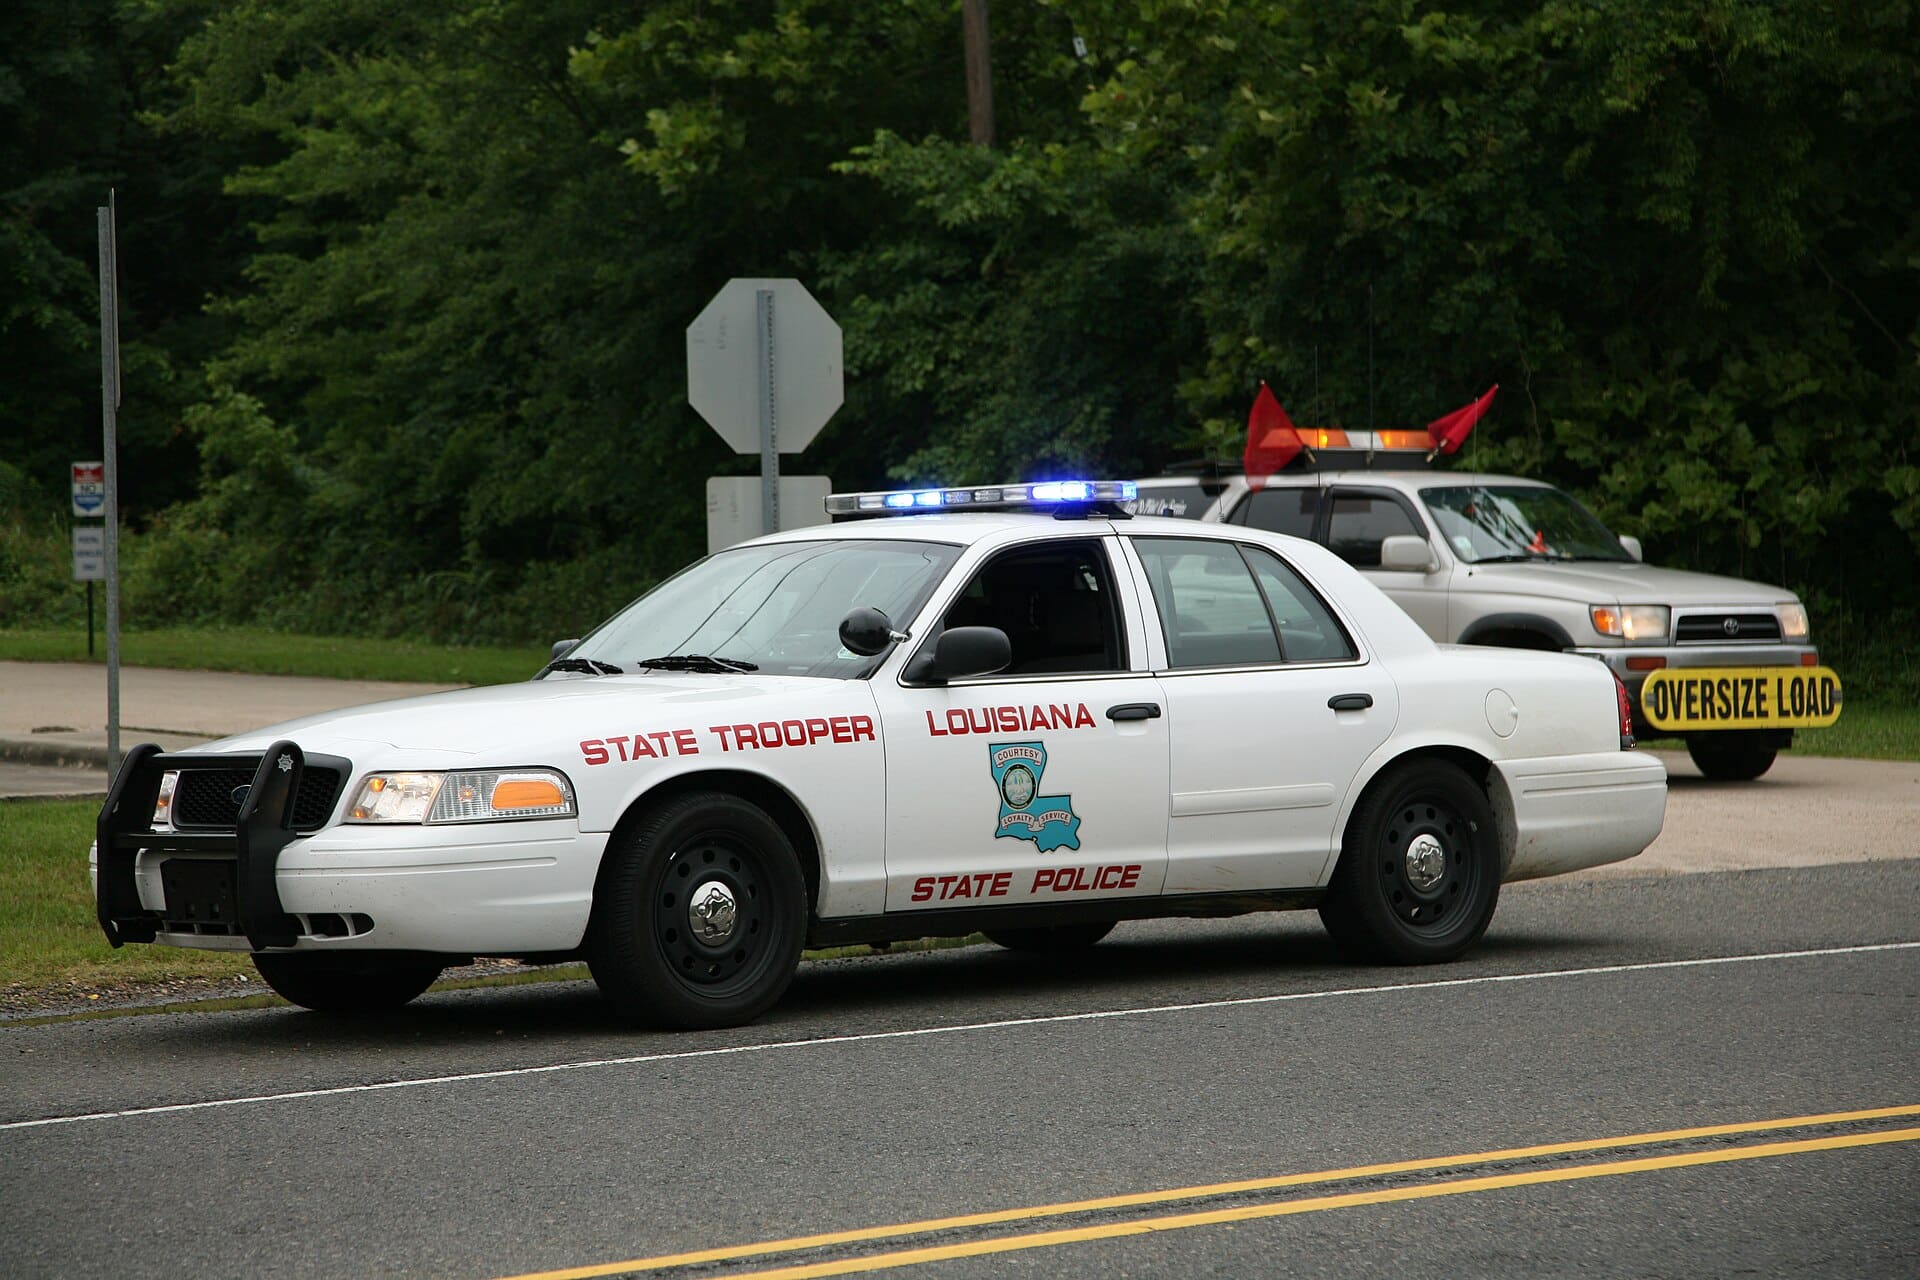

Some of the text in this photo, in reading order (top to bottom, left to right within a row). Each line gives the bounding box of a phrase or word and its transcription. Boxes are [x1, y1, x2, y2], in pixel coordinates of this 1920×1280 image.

[1653, 676, 1835, 721] OVERSIZE LOAD
[925, 703, 1097, 737] LOUISIANA
[579, 715, 876, 766] STATE TROOPER
[997, 748, 1040, 761] COURTESY
[1003, 812, 1069, 825] LOYALTY SERVICE
[911, 864, 1142, 902] STATE POLICE
